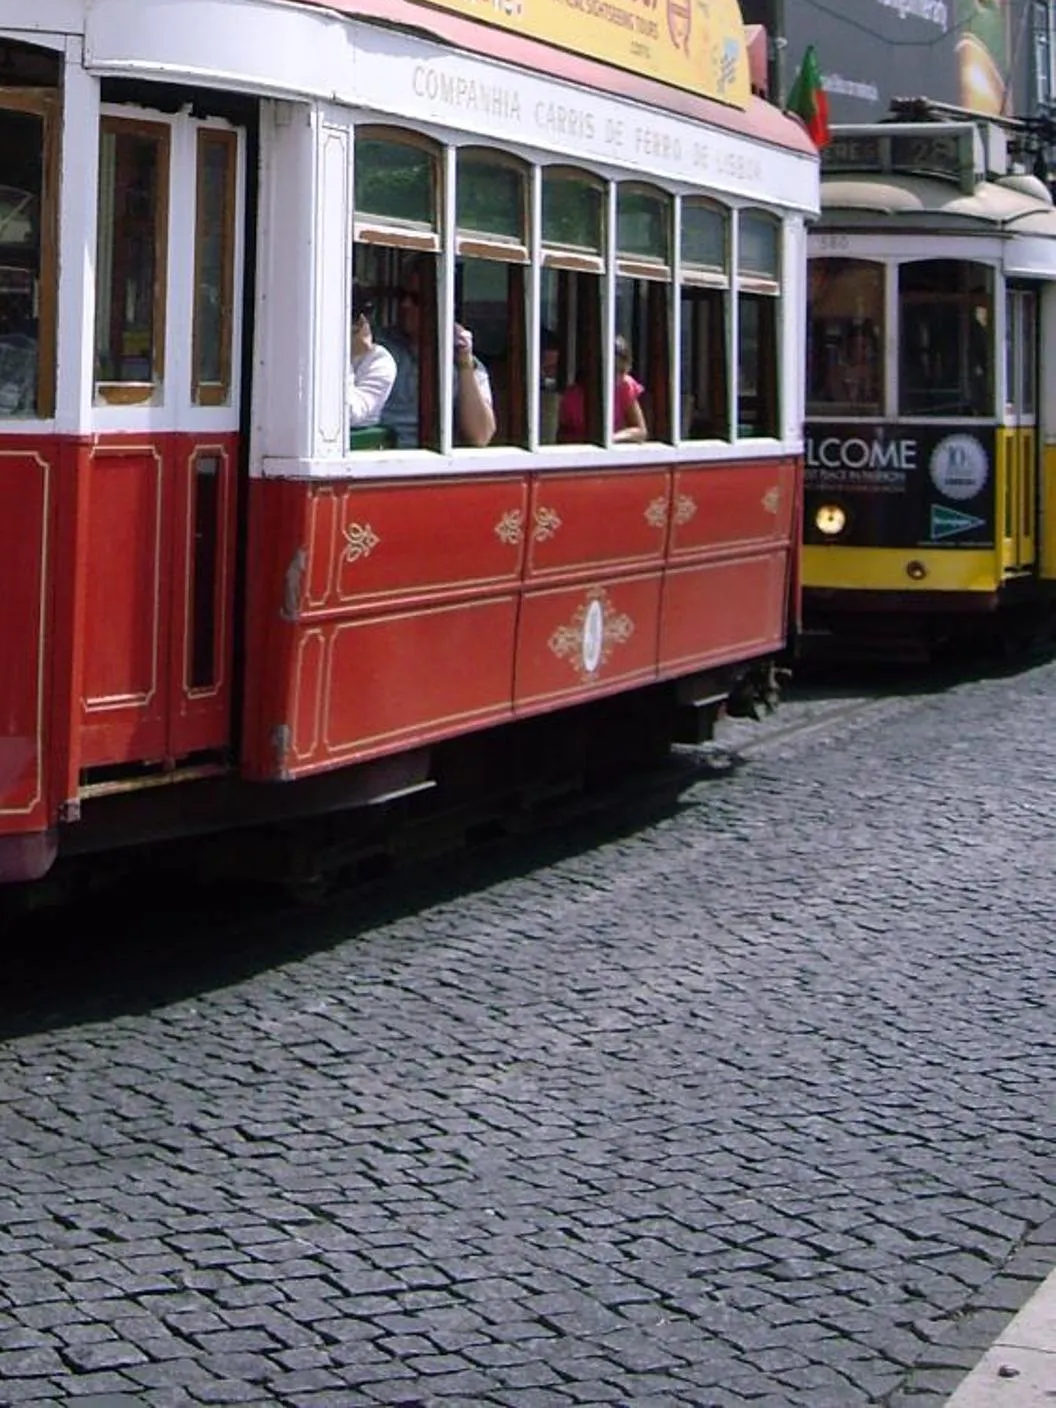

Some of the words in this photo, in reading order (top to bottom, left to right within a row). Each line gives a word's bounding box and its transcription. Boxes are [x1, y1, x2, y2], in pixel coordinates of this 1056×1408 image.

[412, 65, 521, 123] COMPANHIA
[534, 100, 596, 139] CARRIS
[605, 118, 624, 146] DE
[807, 438, 917, 469] LCOME
